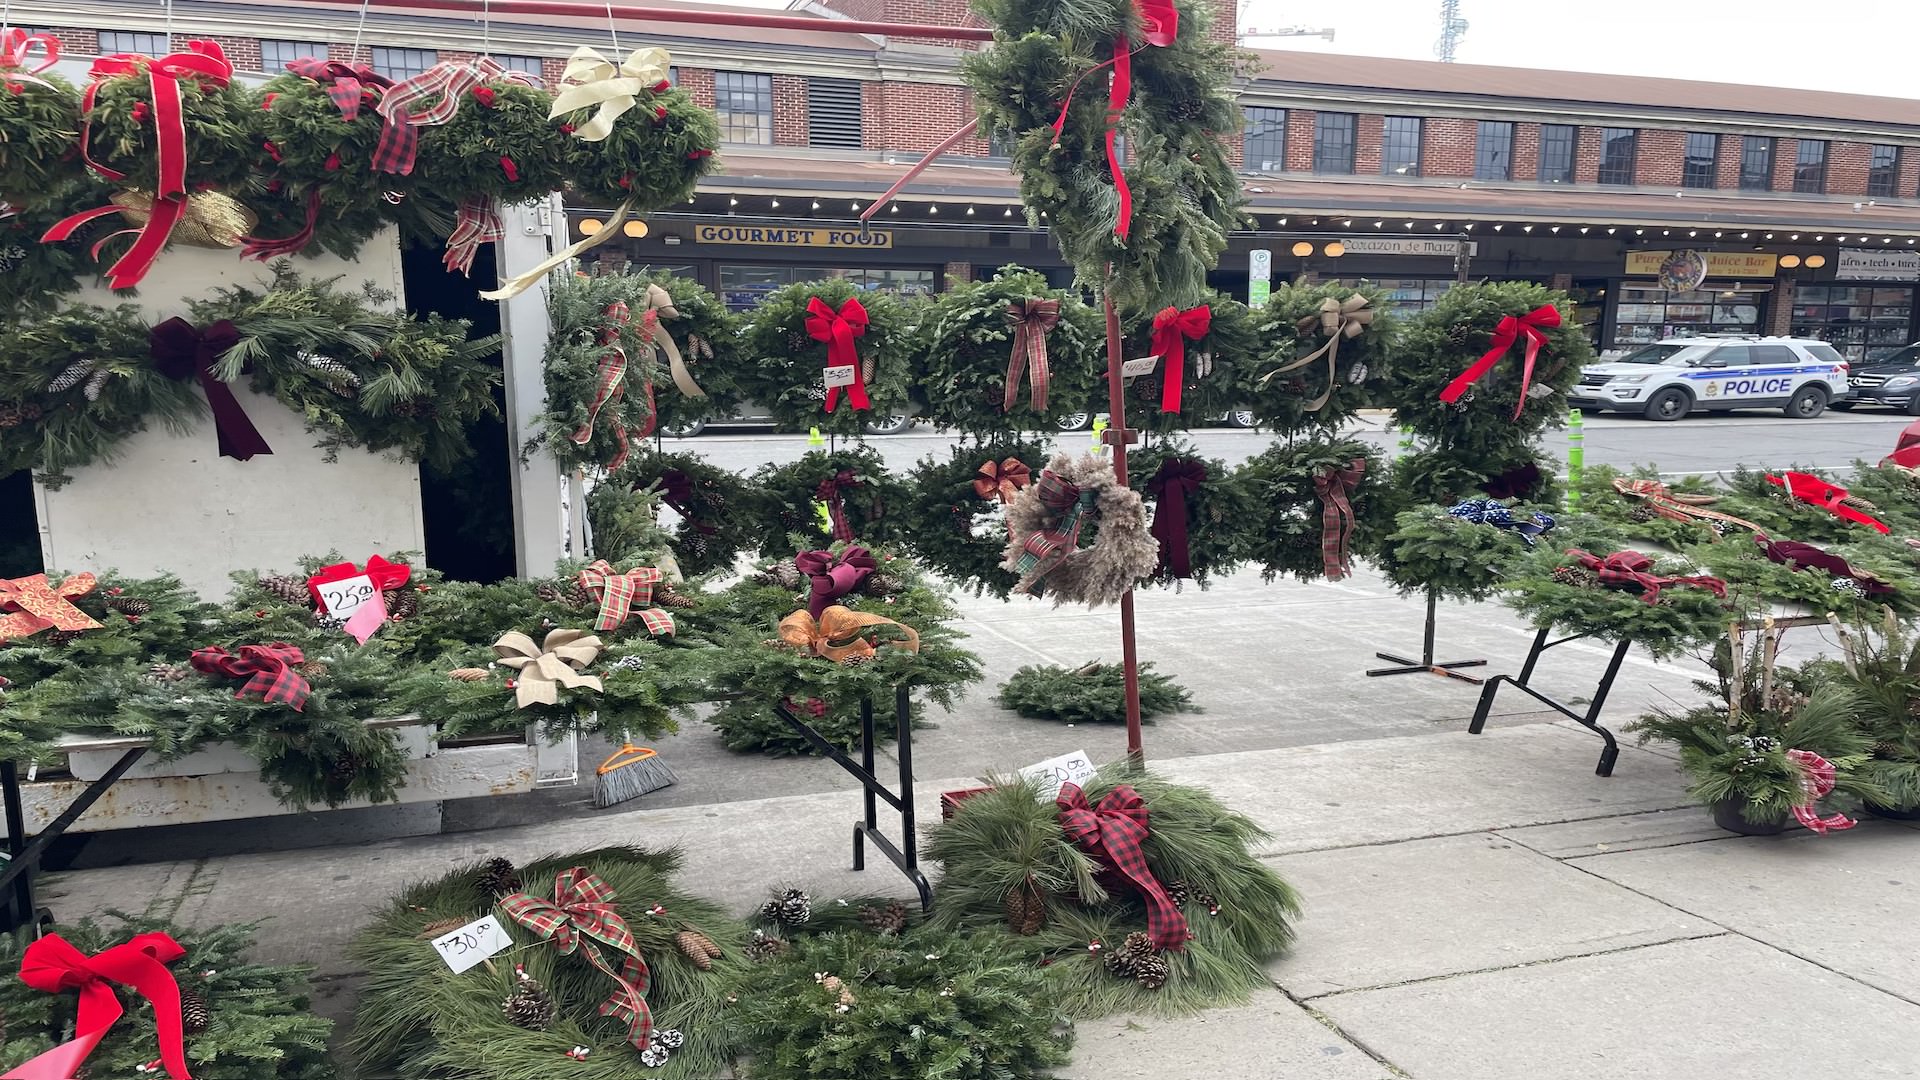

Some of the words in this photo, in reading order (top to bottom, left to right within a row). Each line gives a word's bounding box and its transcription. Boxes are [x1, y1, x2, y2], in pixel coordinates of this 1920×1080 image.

[702, 227, 814, 244] GOURMET
[829, 231, 888, 246] FOOD
[1405, 241, 1420, 251] de
[1634, 254, 1664, 264] Pure
[1710, 255, 1741, 266] Juice
[1745, 256, 1768, 266] Bar
[1869, 258, 1889, 267] tech
[1724, 378, 1792, 395] POLICE
